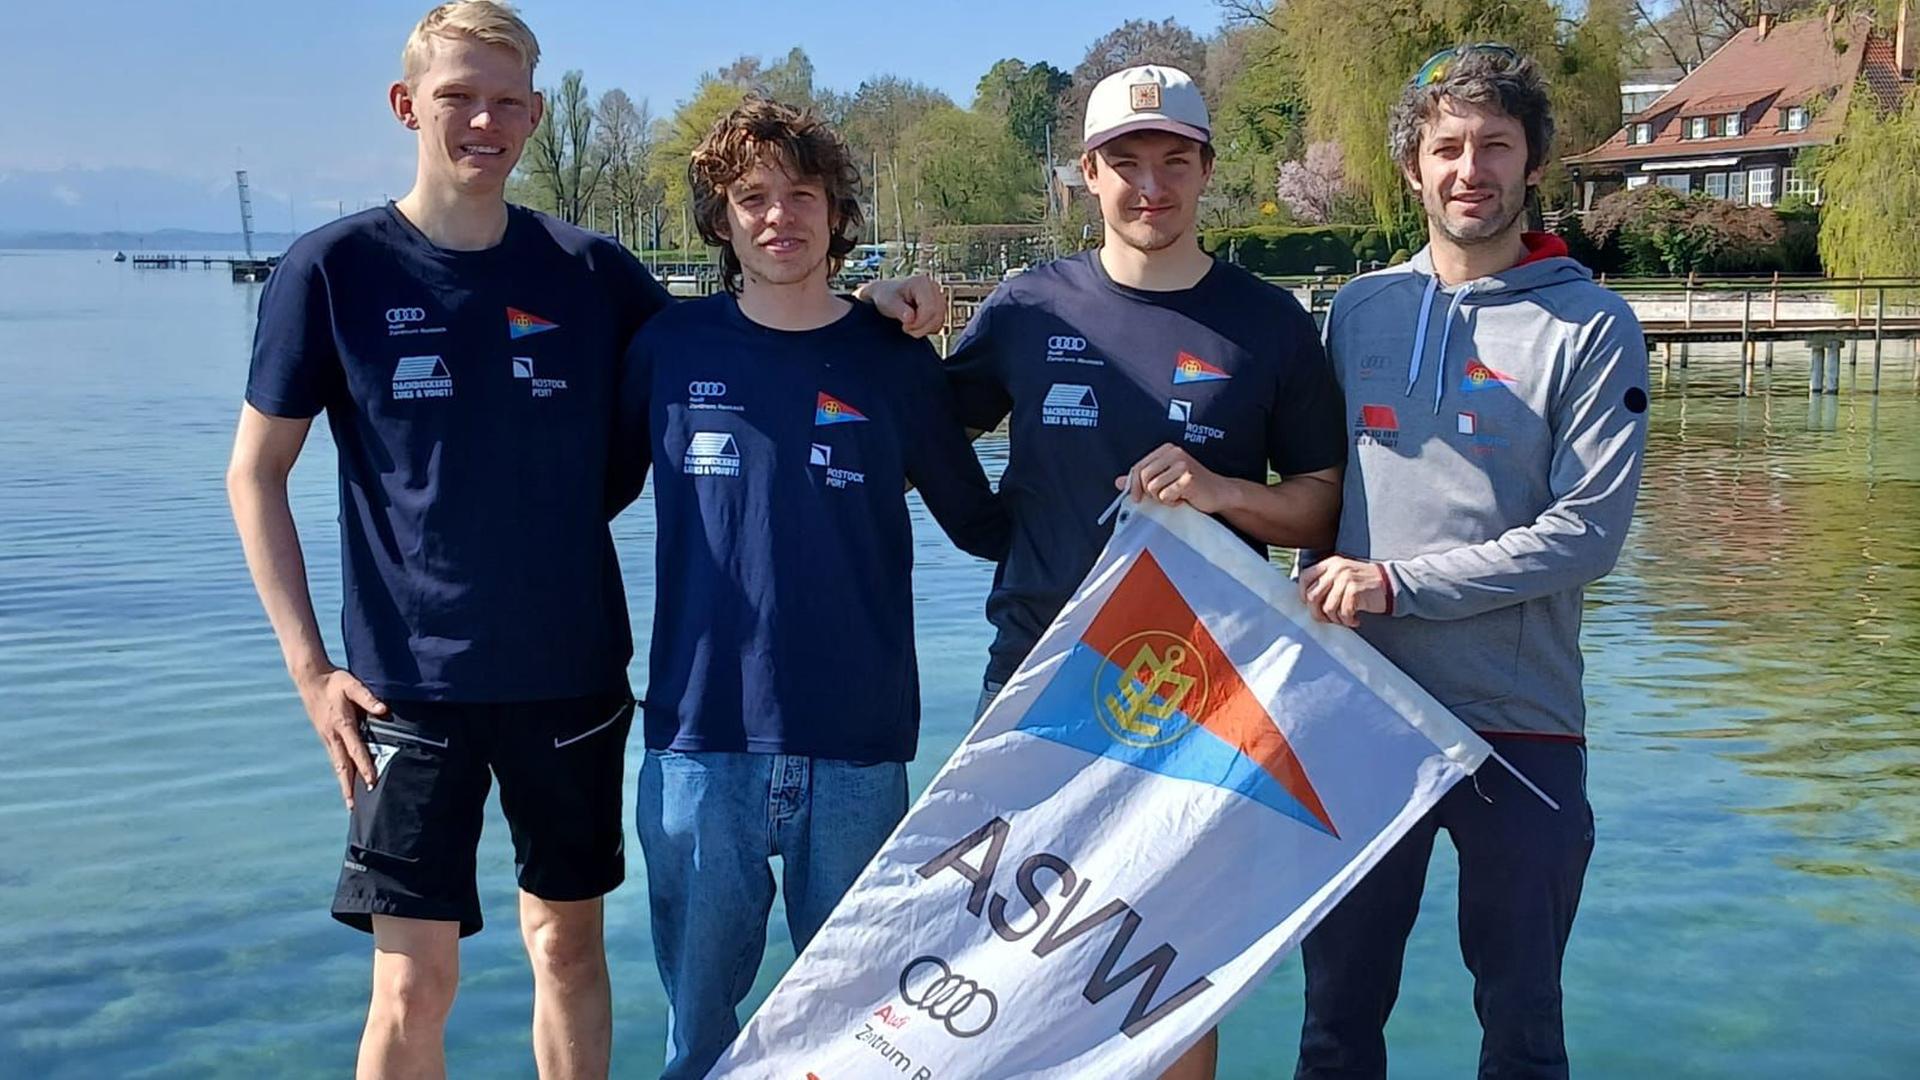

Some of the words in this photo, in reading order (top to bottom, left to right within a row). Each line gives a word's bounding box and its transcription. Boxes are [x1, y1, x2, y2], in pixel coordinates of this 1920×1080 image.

[531, 378, 568, 389] ROSTOCK
[531, 388, 553, 398] PORT
[1185, 422, 1225, 440] ROSTOCK
[1184, 432, 1207, 446] PORT
[826, 467, 865, 483] ROSTOCK
[826, 477, 847, 489] PORT
[915, 816, 1215, 1040] ASVW
